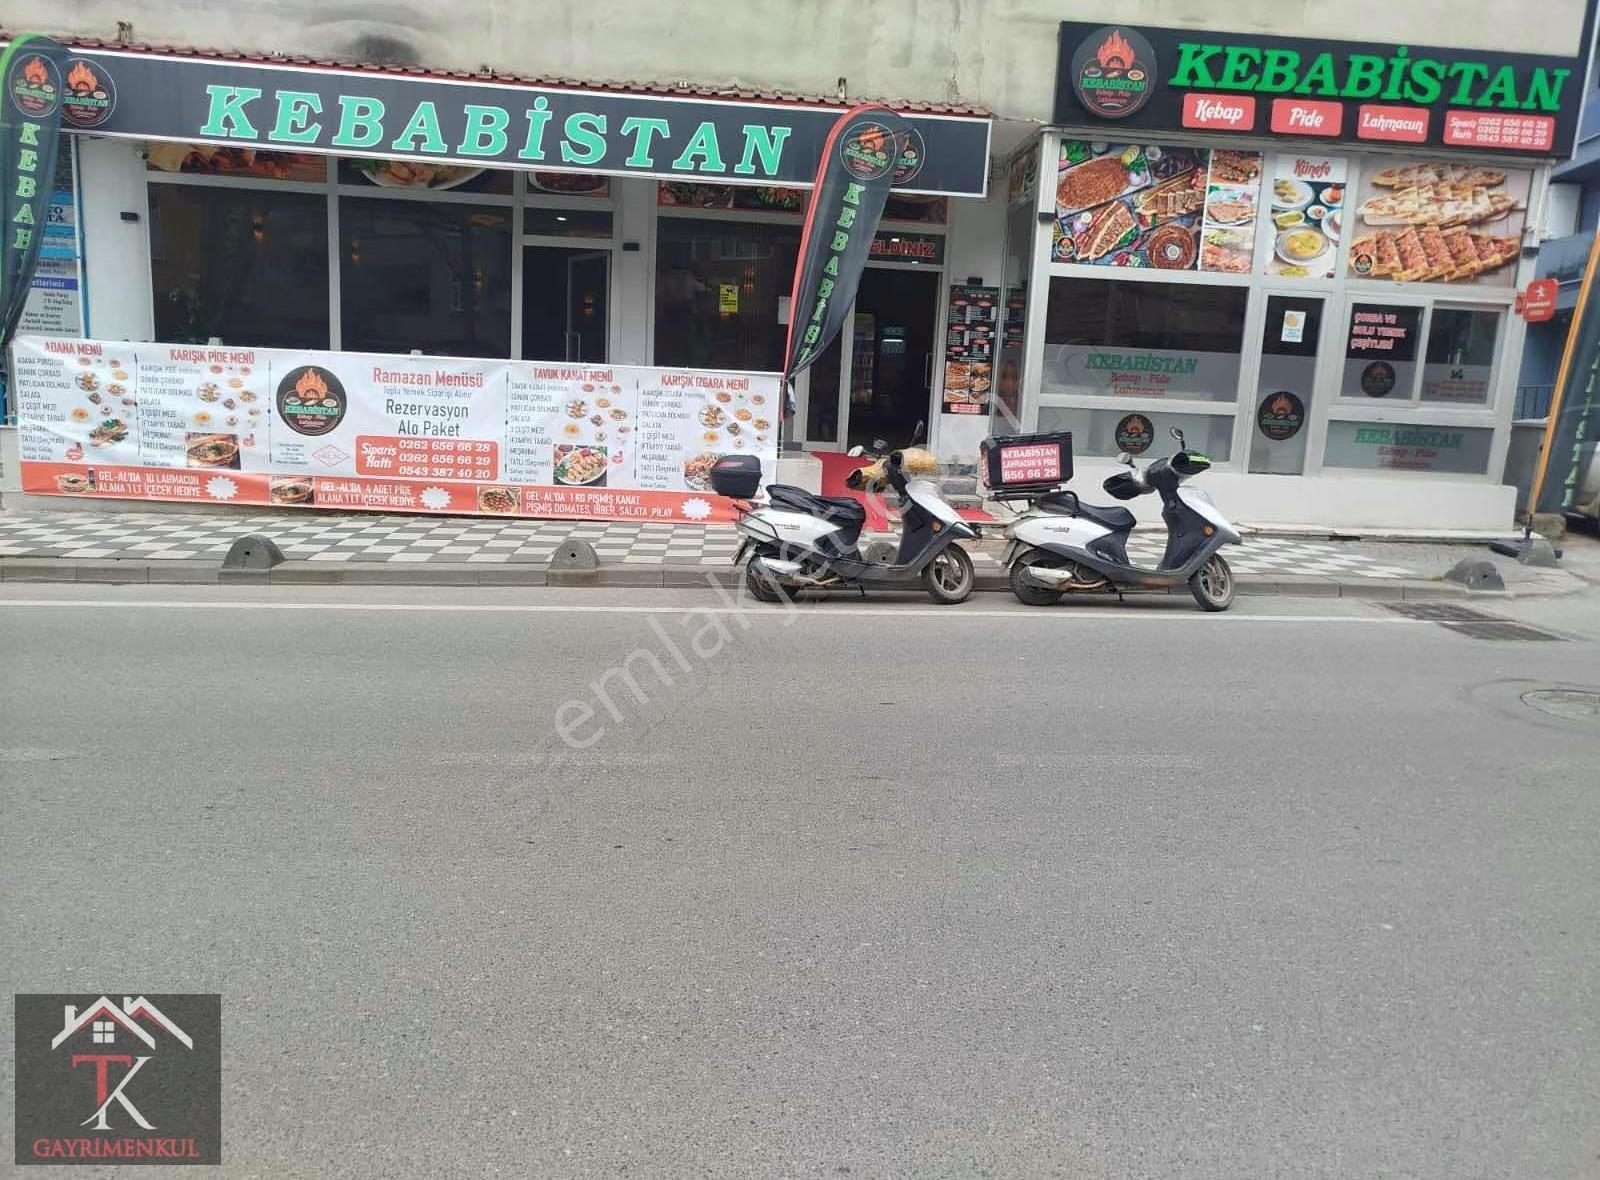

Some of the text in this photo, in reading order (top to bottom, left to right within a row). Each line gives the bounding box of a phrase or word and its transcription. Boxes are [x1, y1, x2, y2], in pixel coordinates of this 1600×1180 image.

[1168, 43, 1571, 111] KEBABİSTAN
[1194, 98, 1244, 125] Kebap
[1289, 106, 1325, 128] Pide
[200, 84, 792, 176] KEBABİSTAN
[1362, 112, 1424, 135] Lahmacun
[1294, 159, 1332, 178] Künefe
[45, 341, 102, 356] ADANA MENÜ
[170, 349, 255, 364] KARIŞIK PİDE MENÜ
[373, 367, 483, 388] Ramazan Menüsü
[533, 368, 613, 382] TAVUK KANAT MENÜ
[661, 373, 694, 388] KARIŞIK
[726, 378, 749, 390] MENÜ
[385, 398, 469, 421] Rezervasyon
[398, 419, 461, 437] Alo Paket
[399, 440, 490, 453] 0262 656 66 28
[1002, 446, 1057, 459] KEBABİSTAN
[399, 453, 490, 466] 0262 656 66 29
[155, 473, 200, 485] LAHMACUN
[399, 465, 490, 479] 0543 387 40 20
[1004, 467, 1057, 480] 656 66 29
[98, 482, 125, 493] ALANA
[373, 484, 393, 494] ADET
[394, 484, 411, 495] PİDE
[317, 493, 343, 504] ALANA
[525, 490, 565, 502] GEL-AL'DA
[615, 495, 641, 506] KANAT
[554, 503, 592, 515] DOMATES,
[619, 506, 648, 517] SALATA
[651, 507, 673, 518] PİLAV
